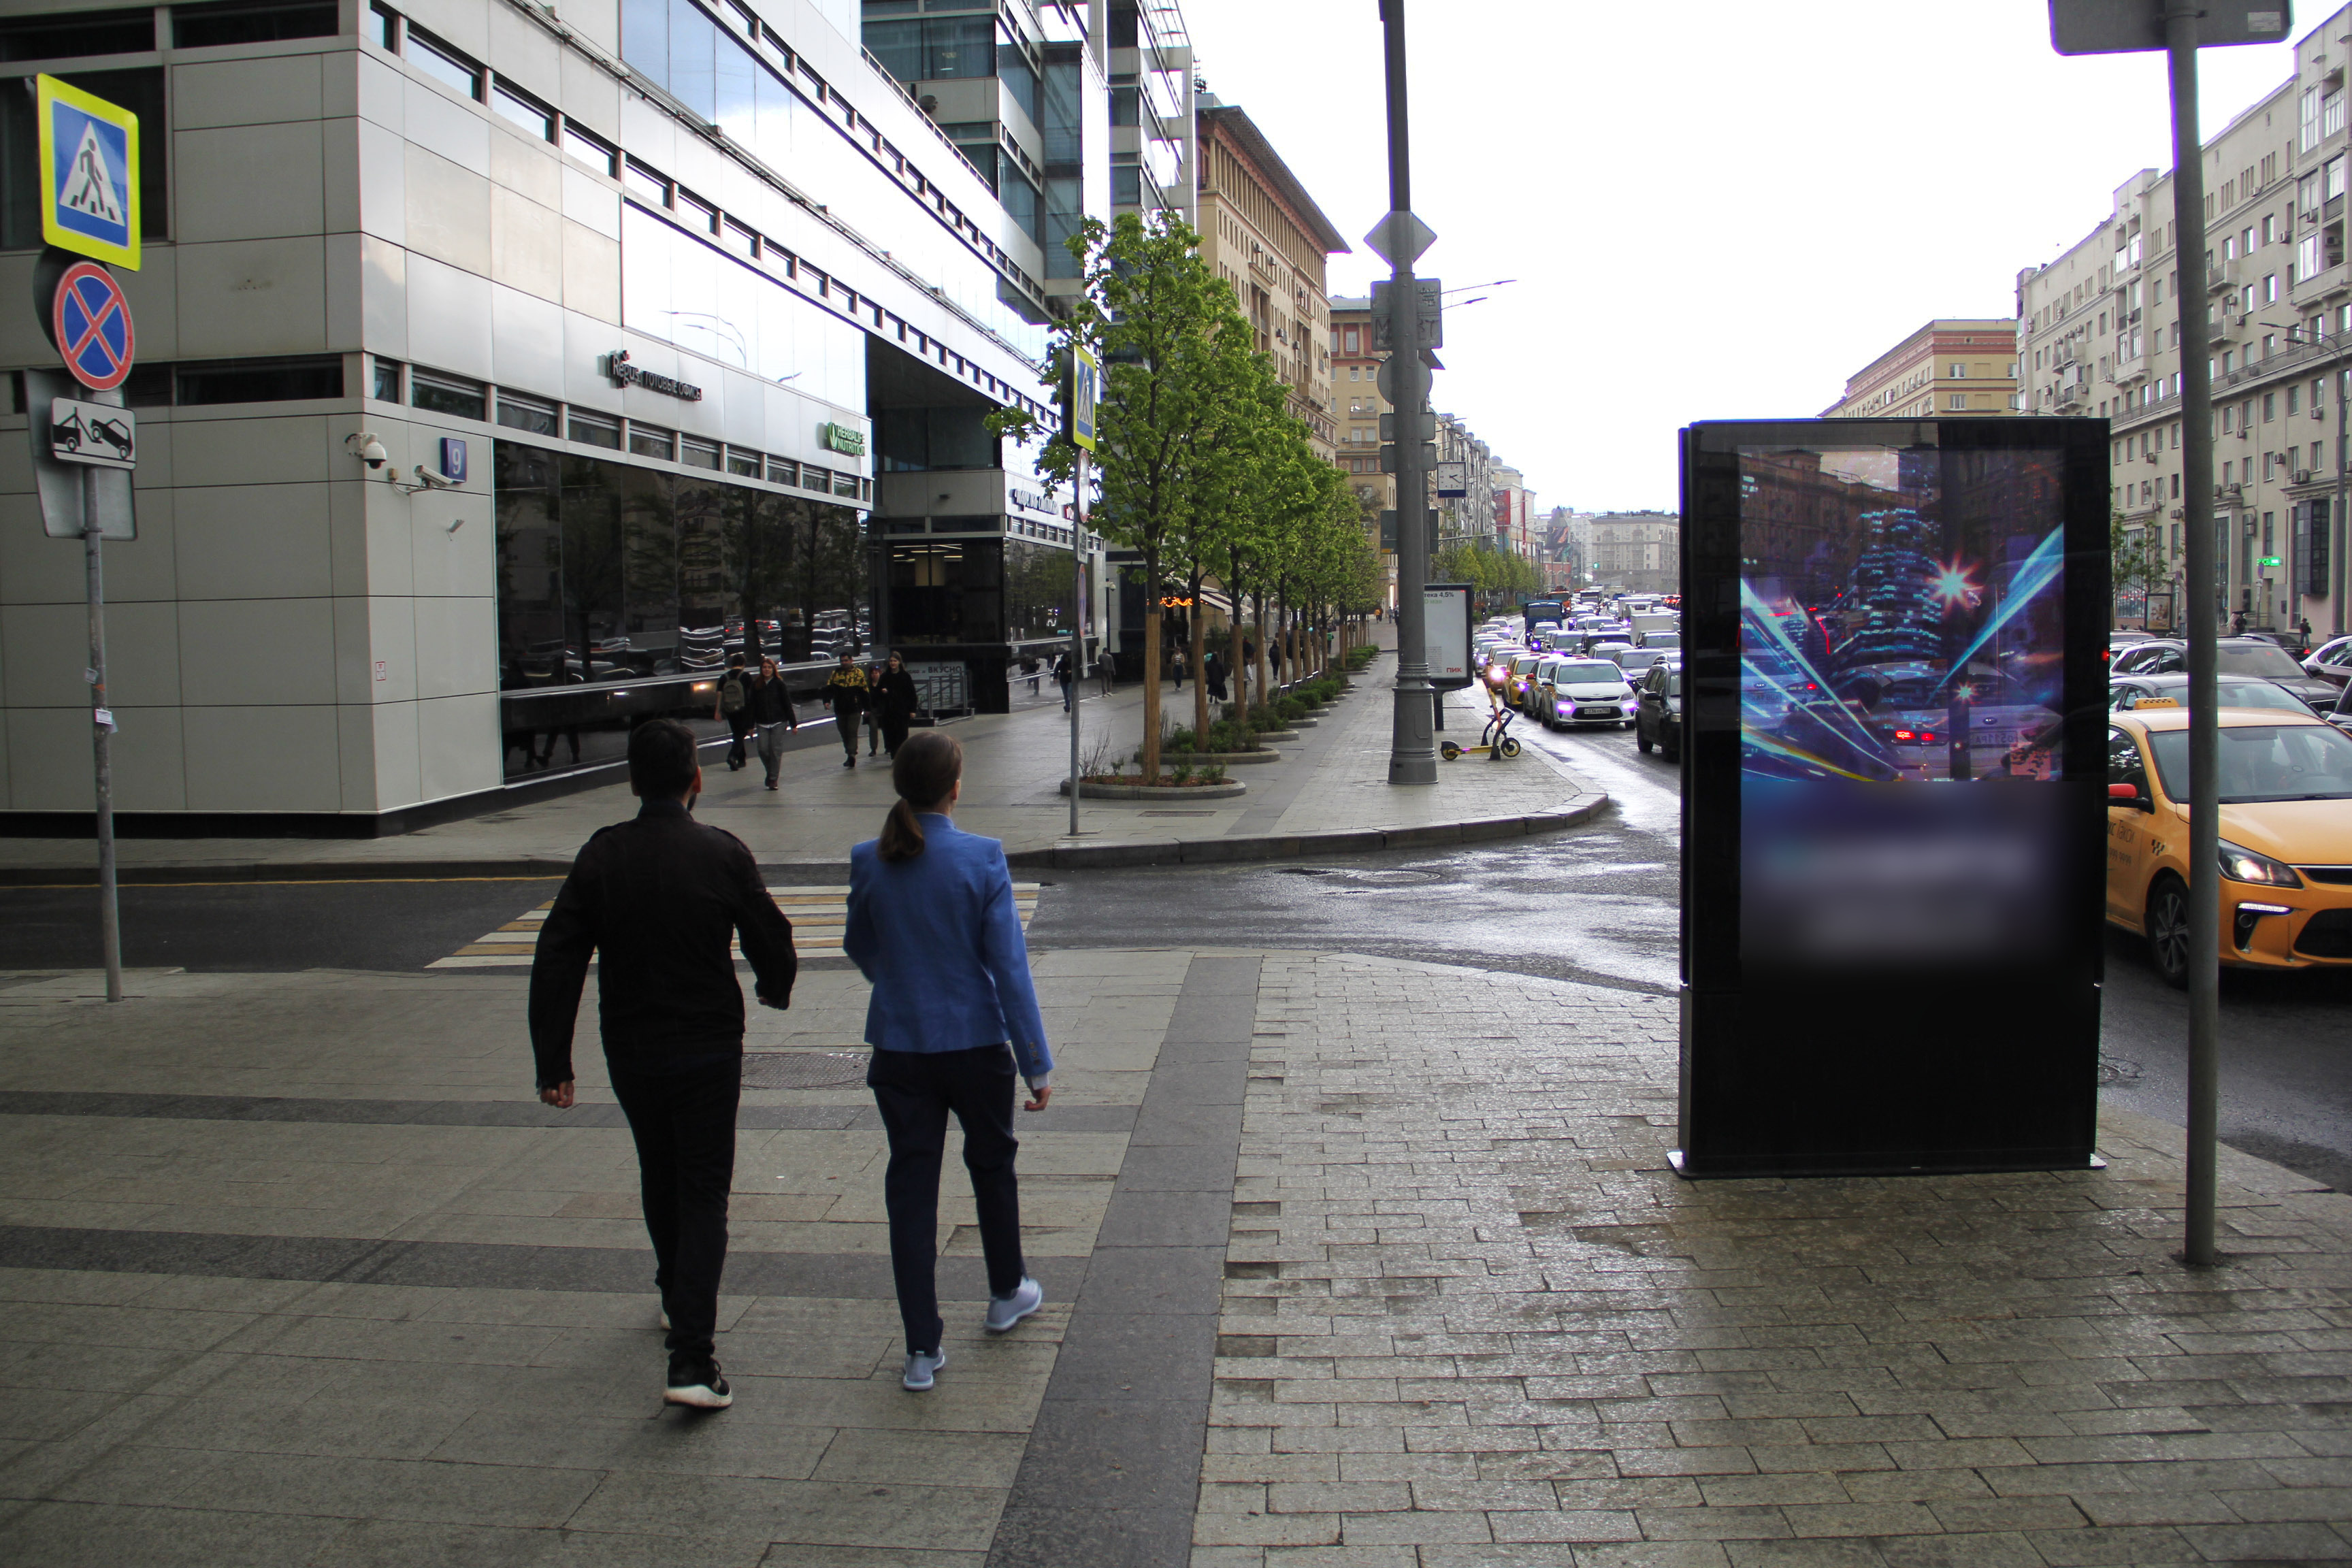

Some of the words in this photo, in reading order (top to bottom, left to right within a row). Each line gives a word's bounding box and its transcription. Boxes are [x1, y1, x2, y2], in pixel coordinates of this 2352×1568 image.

[612, 355, 640, 387] Regus
[644, 372, 677, 393] ГОТОВЫЕ
[678, 382, 702, 400] ОФИСЫ
[837, 425, 865, 444] HERBALIFE
[837, 438, 865, 456] NUTRITION
[452, 448, 462, 474] 9
